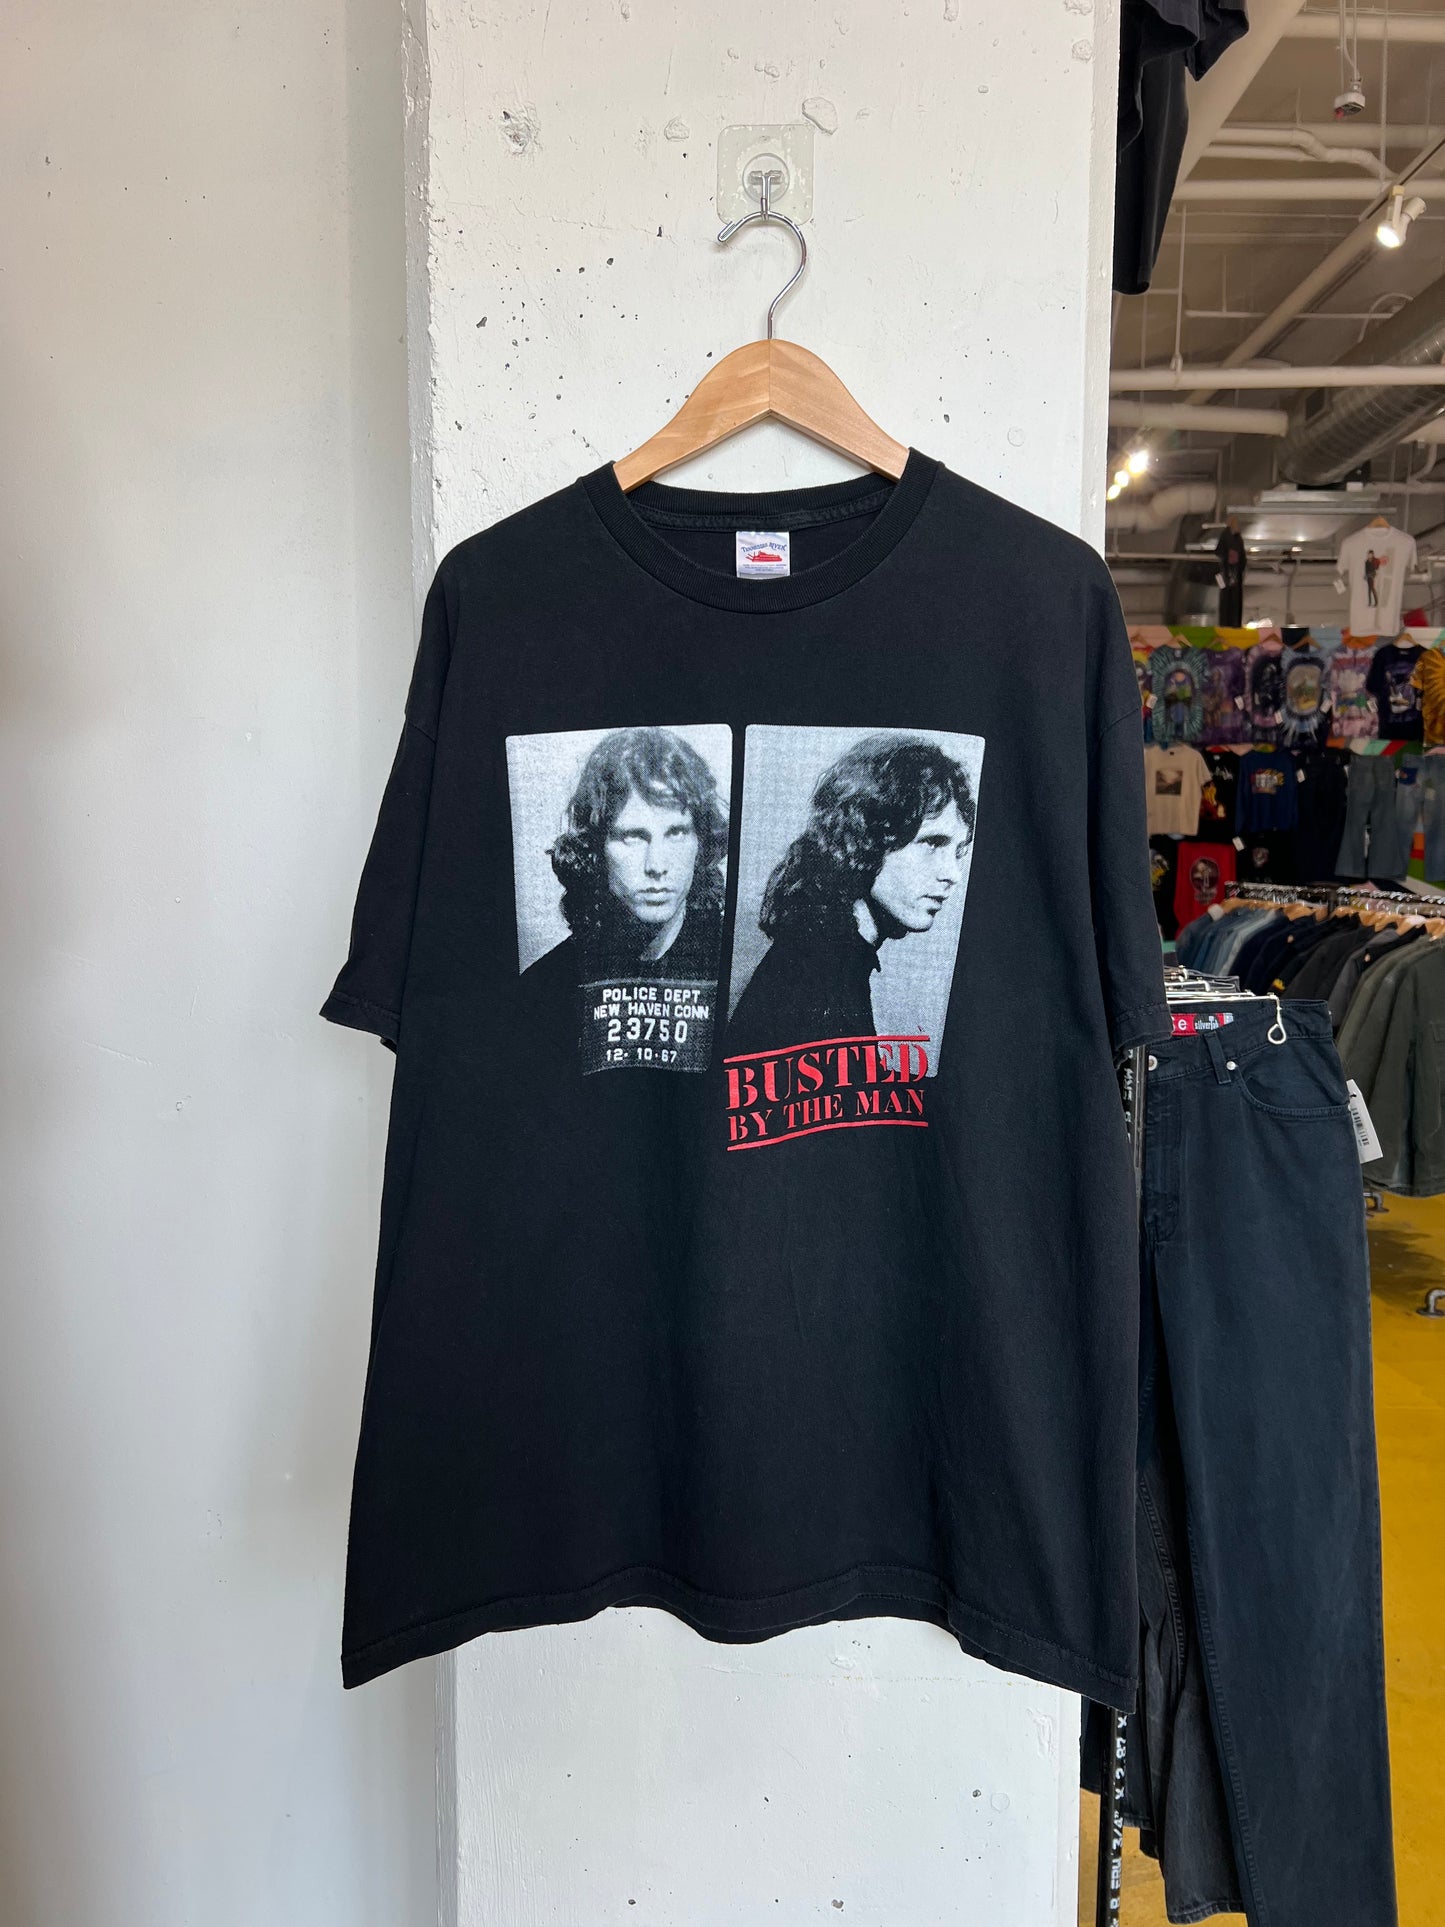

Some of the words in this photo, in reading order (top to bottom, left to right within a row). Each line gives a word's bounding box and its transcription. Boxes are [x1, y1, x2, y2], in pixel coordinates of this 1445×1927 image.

[602, 987, 658, 1003] POLICE
[664, 988, 701, 1003] DEPT
[593, 1004, 620, 1020] NEW
[627, 1002, 670, 1017] HAVEN
[674, 1005, 710, 1019] CONN
[607, 1017, 688, 1043] 23750
[724, 1043, 928, 1110] BUSTED
[728, 1109, 773, 1141] BY
[783, 1093, 844, 1129] THE
[855, 1088, 925, 1117] MAN
